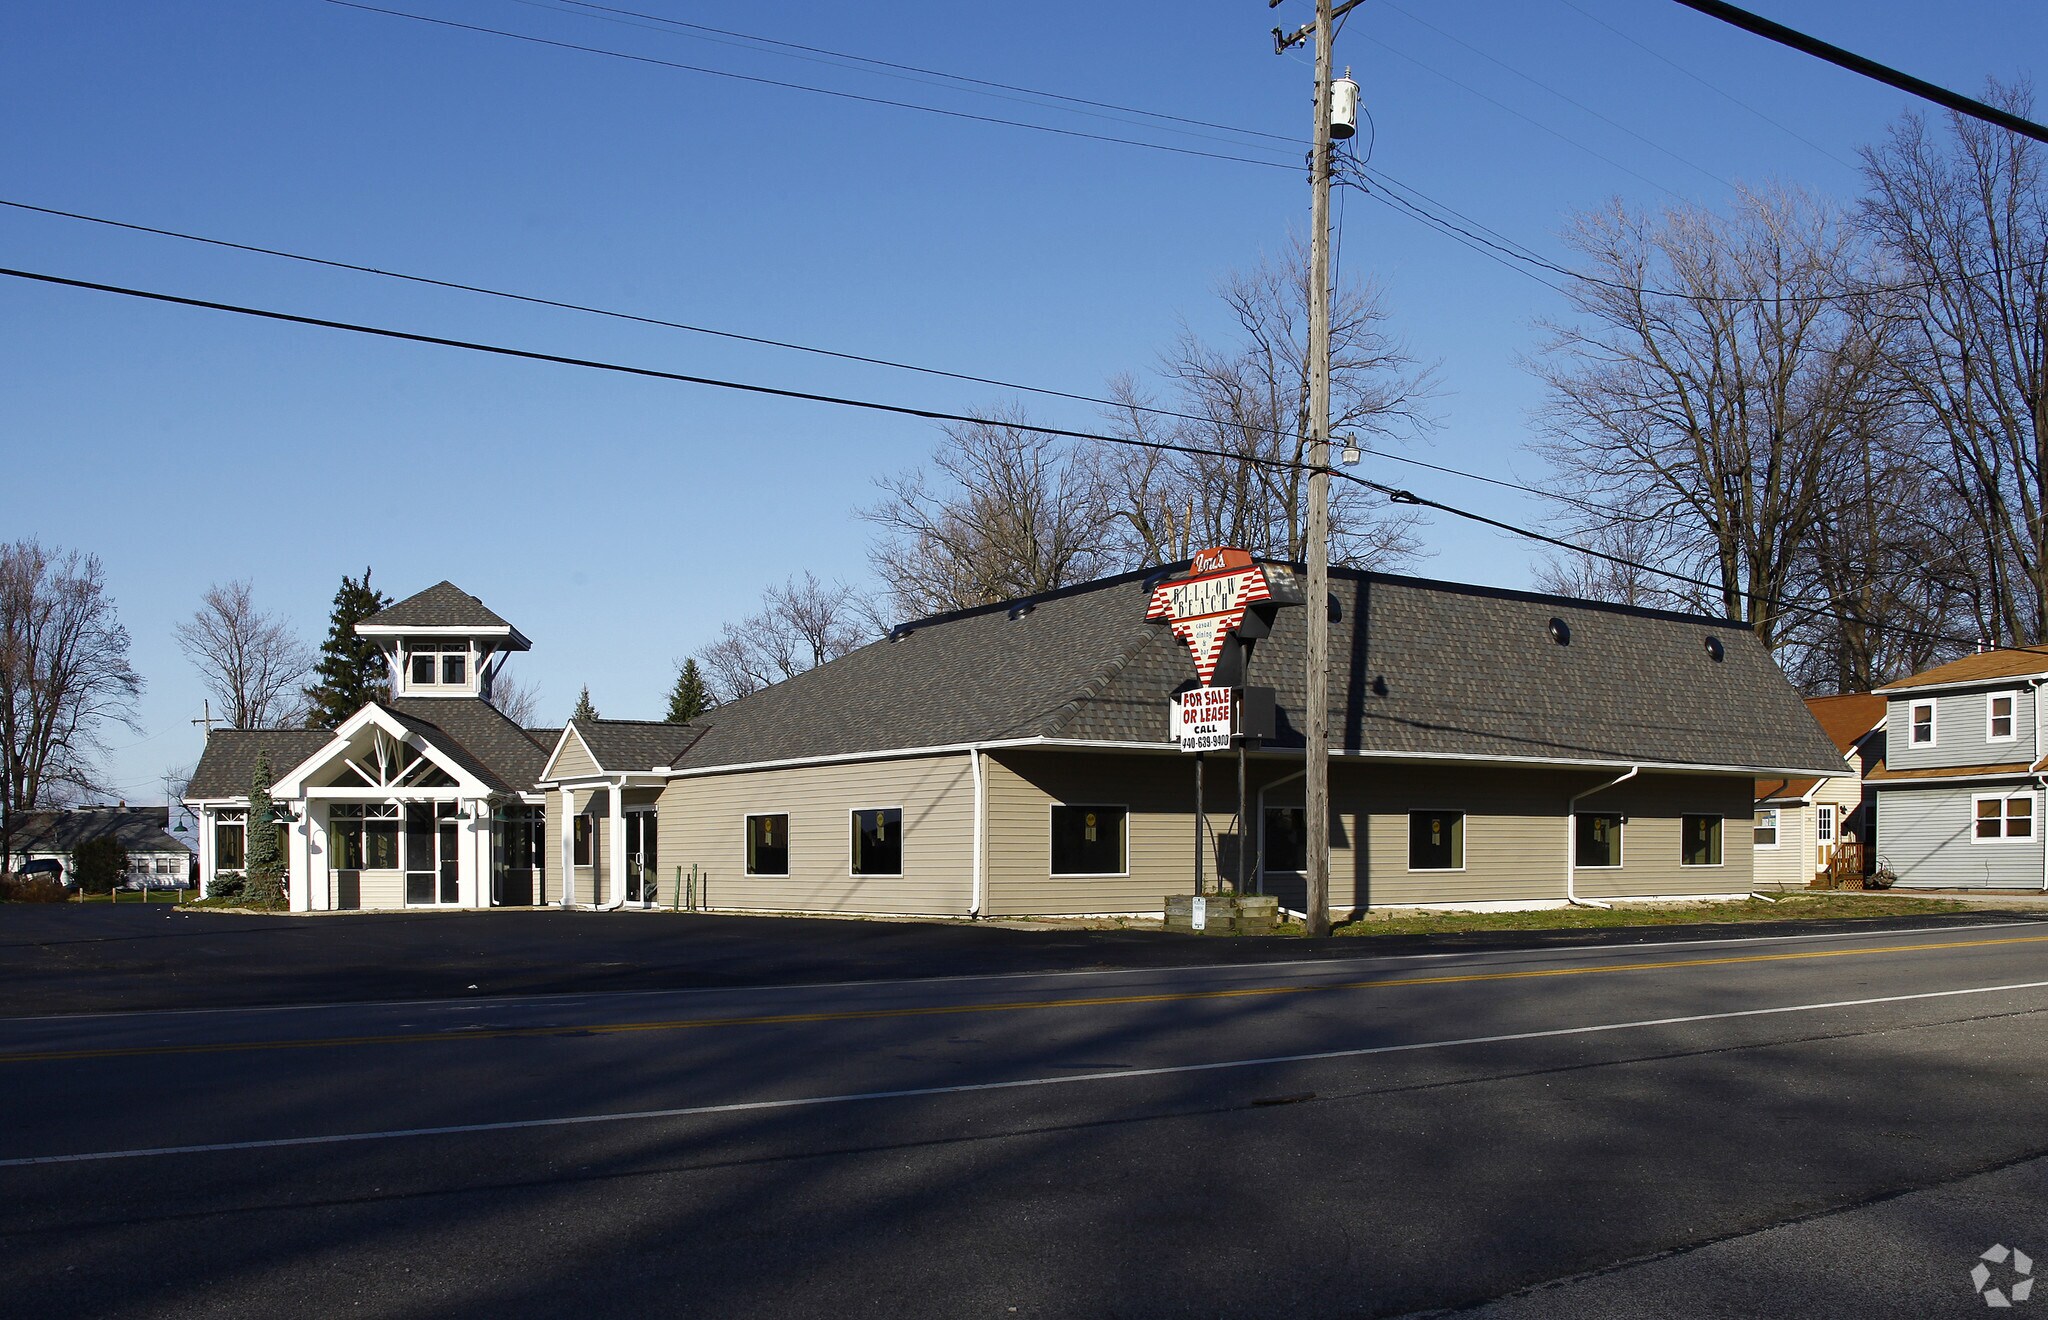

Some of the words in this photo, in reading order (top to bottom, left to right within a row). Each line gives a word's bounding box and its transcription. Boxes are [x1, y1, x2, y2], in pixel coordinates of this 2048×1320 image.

[1196, 620, 1211, 628] casual
[1196, 630, 1212, 638] dining
[1184, 692, 1202, 707] FOR
[1204, 689, 1229, 705] SALE
[1183, 709, 1197, 724] OR
[1200, 705, 1229, 723] LEASE
[1194, 725, 1217, 734] CALL
